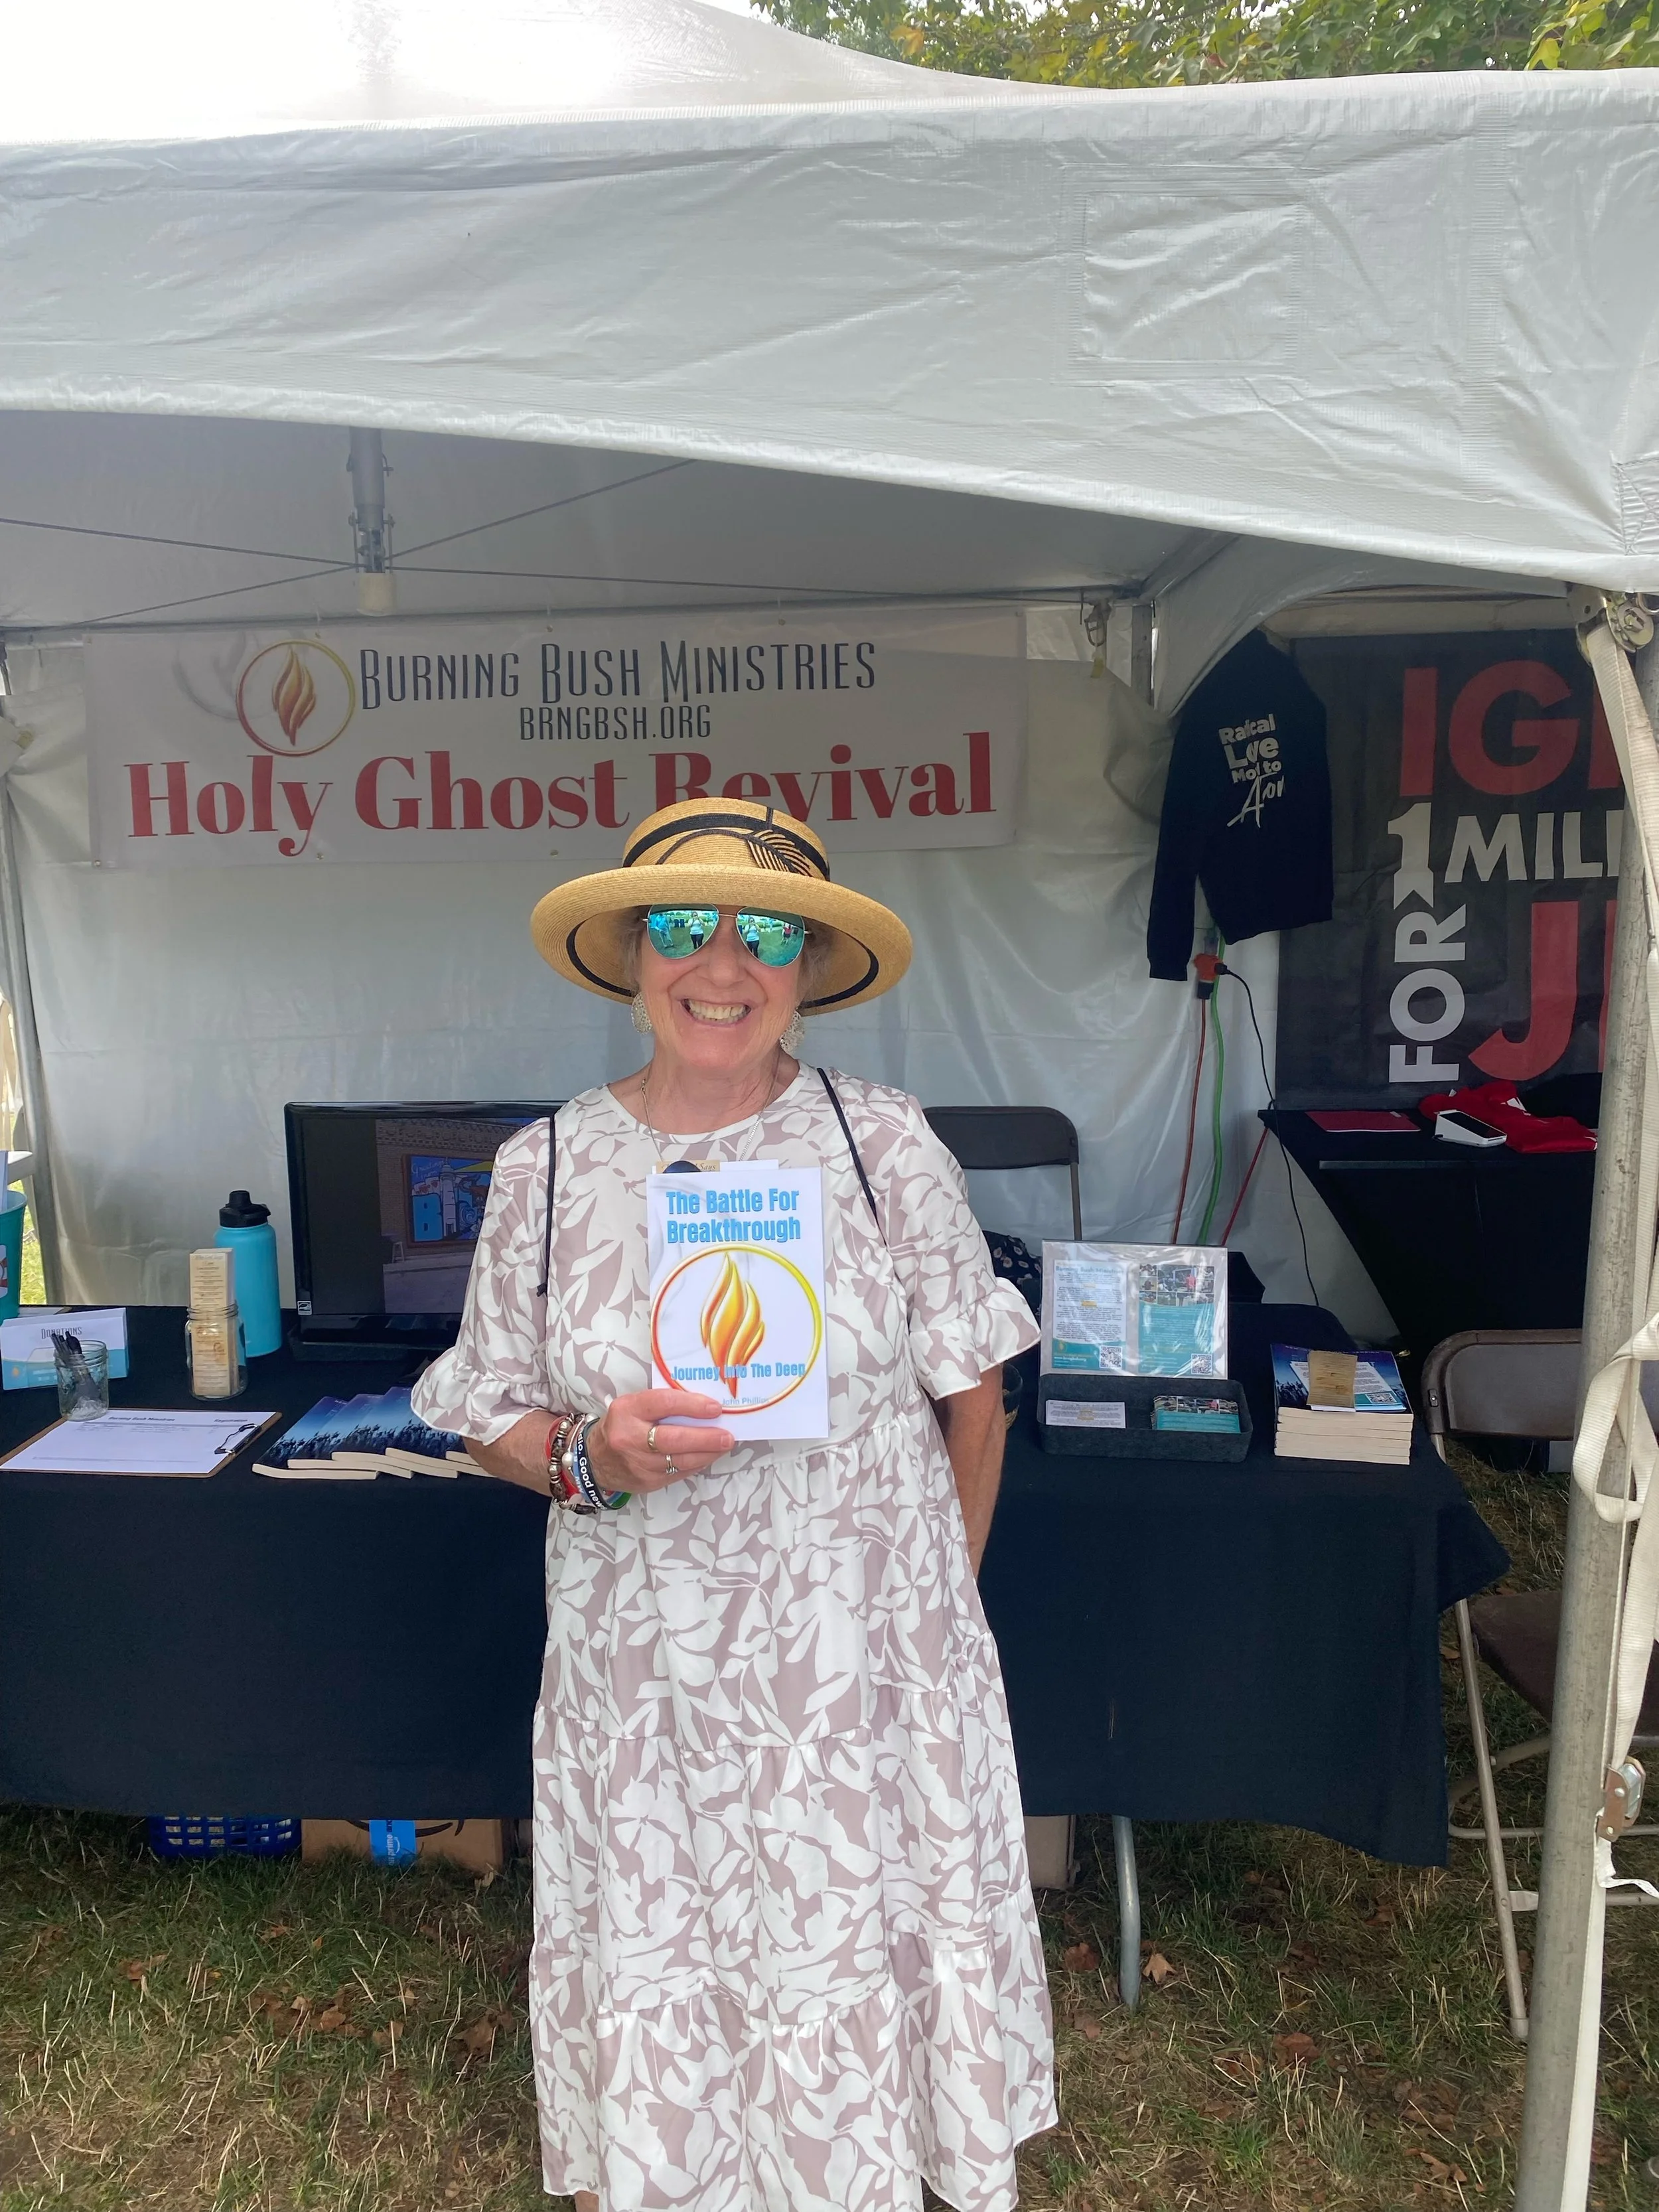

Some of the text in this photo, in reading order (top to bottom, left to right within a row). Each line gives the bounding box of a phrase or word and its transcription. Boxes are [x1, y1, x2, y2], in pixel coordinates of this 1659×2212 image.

[360, 640, 875, 710] BURNING BUSH MINISTRIES
[520, 704, 711, 741] BRNGBSH.ORG
[123, 731, 997, 856] Holy Ghost Revival
[1388, 802, 1434, 910] 1
[1389, 904, 1466, 1083] FOR
[1468, 900, 1618, 1081] J
[666, 1187, 800, 1215] The Battle For
[666, 1216, 802, 1244] Breakthrough
[671, 1361, 806, 1381] Journey Into The Deep
[579, 1456, 595, 1489] Good
